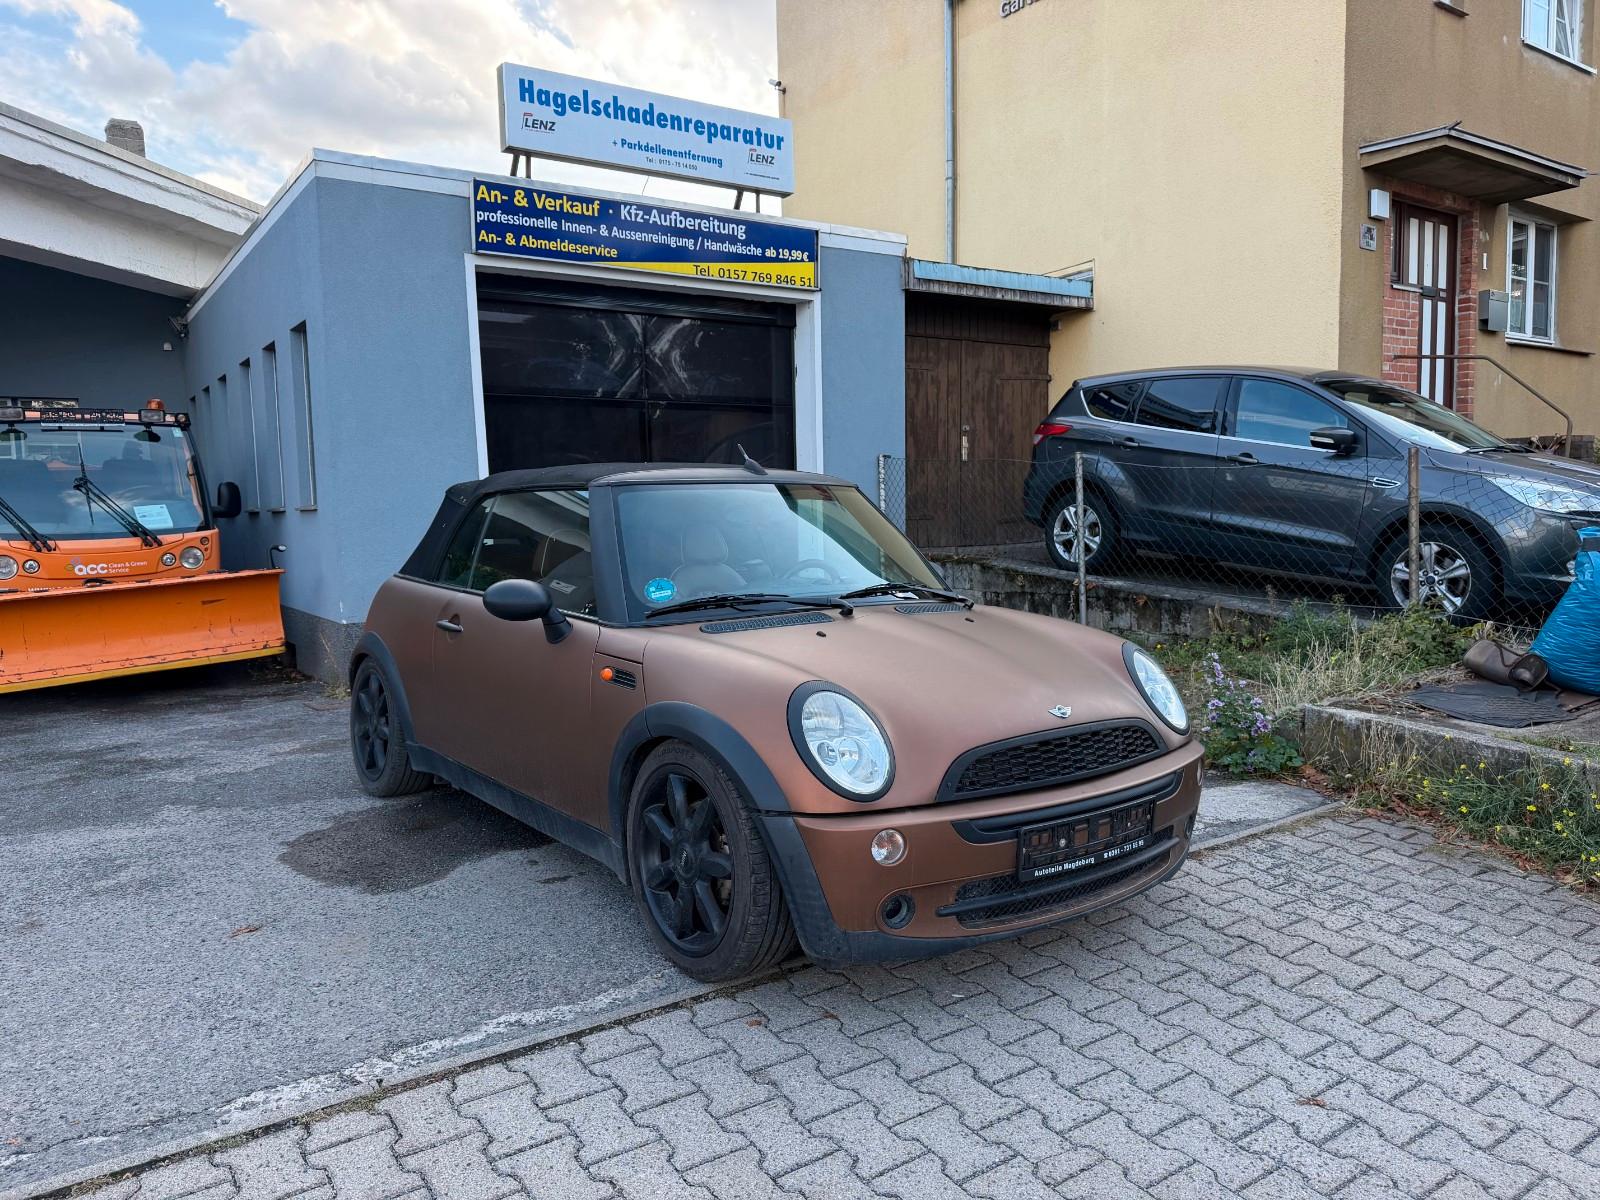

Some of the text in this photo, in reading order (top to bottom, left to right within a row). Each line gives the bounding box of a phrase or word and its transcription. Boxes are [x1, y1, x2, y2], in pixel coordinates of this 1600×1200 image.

[518, 77, 785, 151] Hagelschadenreparatur
[524, 117, 557, 132] LENZ
[620, 138, 723, 169] Parkdellenentfernung
[750, 152, 775, 165] LENZ
[476, 184, 509, 204] An-
[513, 188, 528, 208] &
[532, 191, 600, 217] Verkauf
[620, 204, 746, 240] Kfz-Aufbereitung
[476, 209, 558, 231] professionelle
[561, 219, 598, 235] Innen-
[599, 223, 609, 237] &
[611, 225, 695, 251] Aussenreinigung
[704, 238, 763, 257] Handwäsche
[764, 246, 777, 258] ab
[478, 229, 618, 258] An- & Abmeldeservice
[693, 264, 813, 288] Tel. 0157 769 846 51
[1063, 856, 1095, 870] Magdeburg
